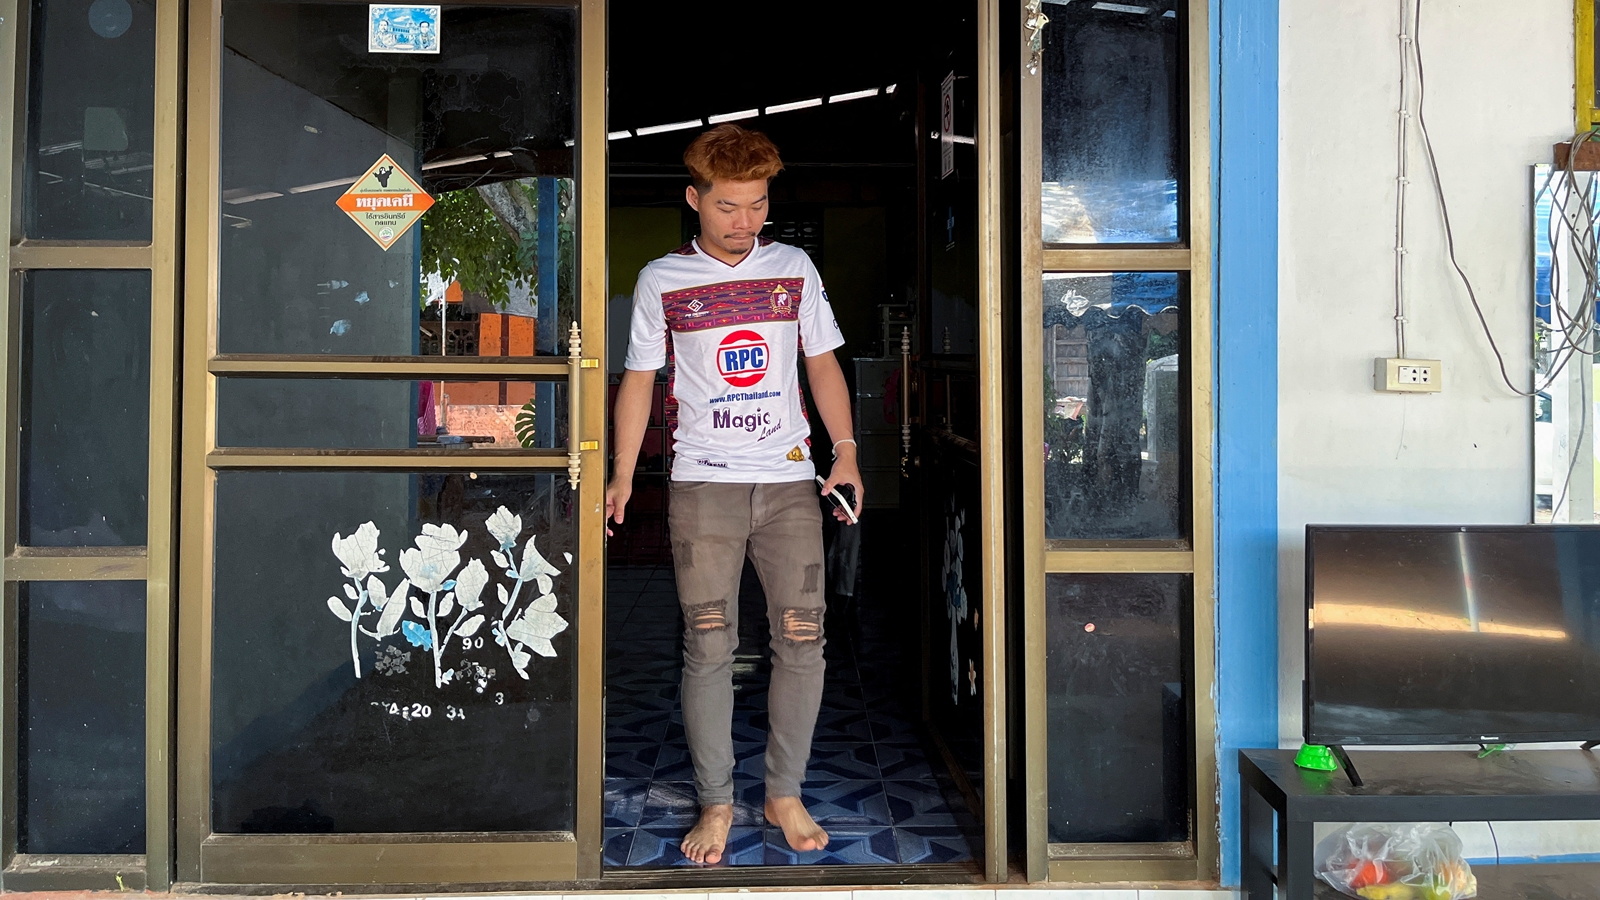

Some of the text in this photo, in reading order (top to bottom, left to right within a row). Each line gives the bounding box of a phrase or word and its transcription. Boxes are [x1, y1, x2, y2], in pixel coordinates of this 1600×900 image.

[724, 347, 764, 371] RPC
[709, 390, 781, 404] www.RPCThailand.com
[712, 407, 771, 433] Magic
[757, 418, 783, 443] Land
[462, 636, 484, 650] 90
